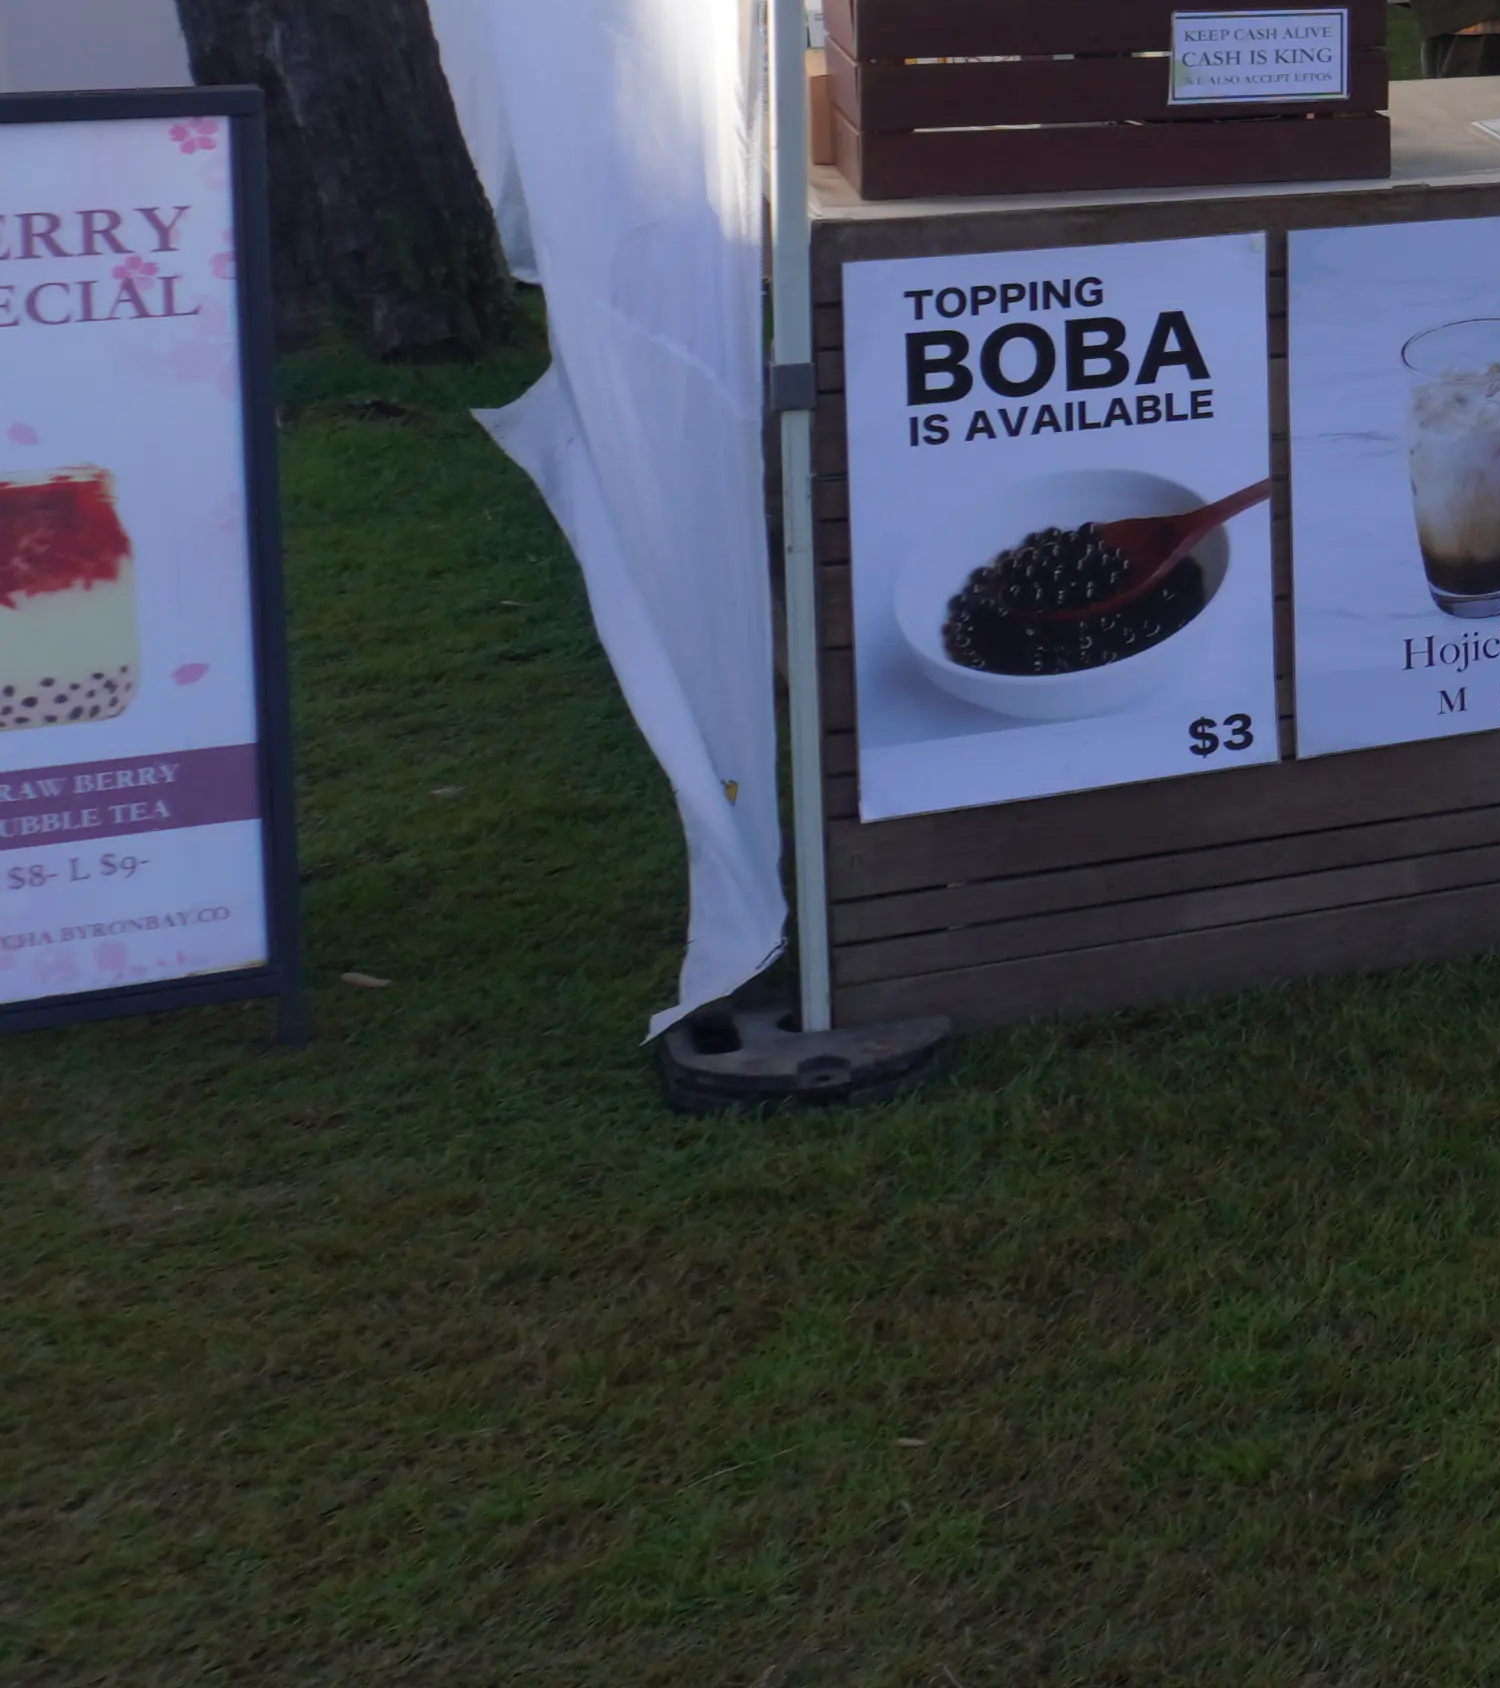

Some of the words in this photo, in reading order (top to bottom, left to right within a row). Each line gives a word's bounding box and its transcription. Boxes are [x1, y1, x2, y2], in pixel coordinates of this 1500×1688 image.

[1184, 29, 1230, 42] KEEP
[1233, 27, 1278, 41] CASH
[1282, 26, 1333, 40] ALIVE
[1182, 50, 1242, 68] CASH
[1250, 49, 1268, 65] IS
[1275, 47, 1333, 64] KING
[1209, 75, 1240, 85] ALSO
[1244, 73, 1291, 84] ACCEPT
[0, 205, 192, 261] RRY
[904, 276, 1104, 320] TOPPING
[905, 310, 1211, 406] BOBA
[909, 414, 949, 447] IS
[965, 389, 1214, 442] AVAILABLE
[1438, 686, 1468, 715] M
[1188, 713, 1254, 758] $3
[73, 763, 180, 794] BERRY
[108, 799, 170, 825] TEA
[69, 858, 90, 882] L
